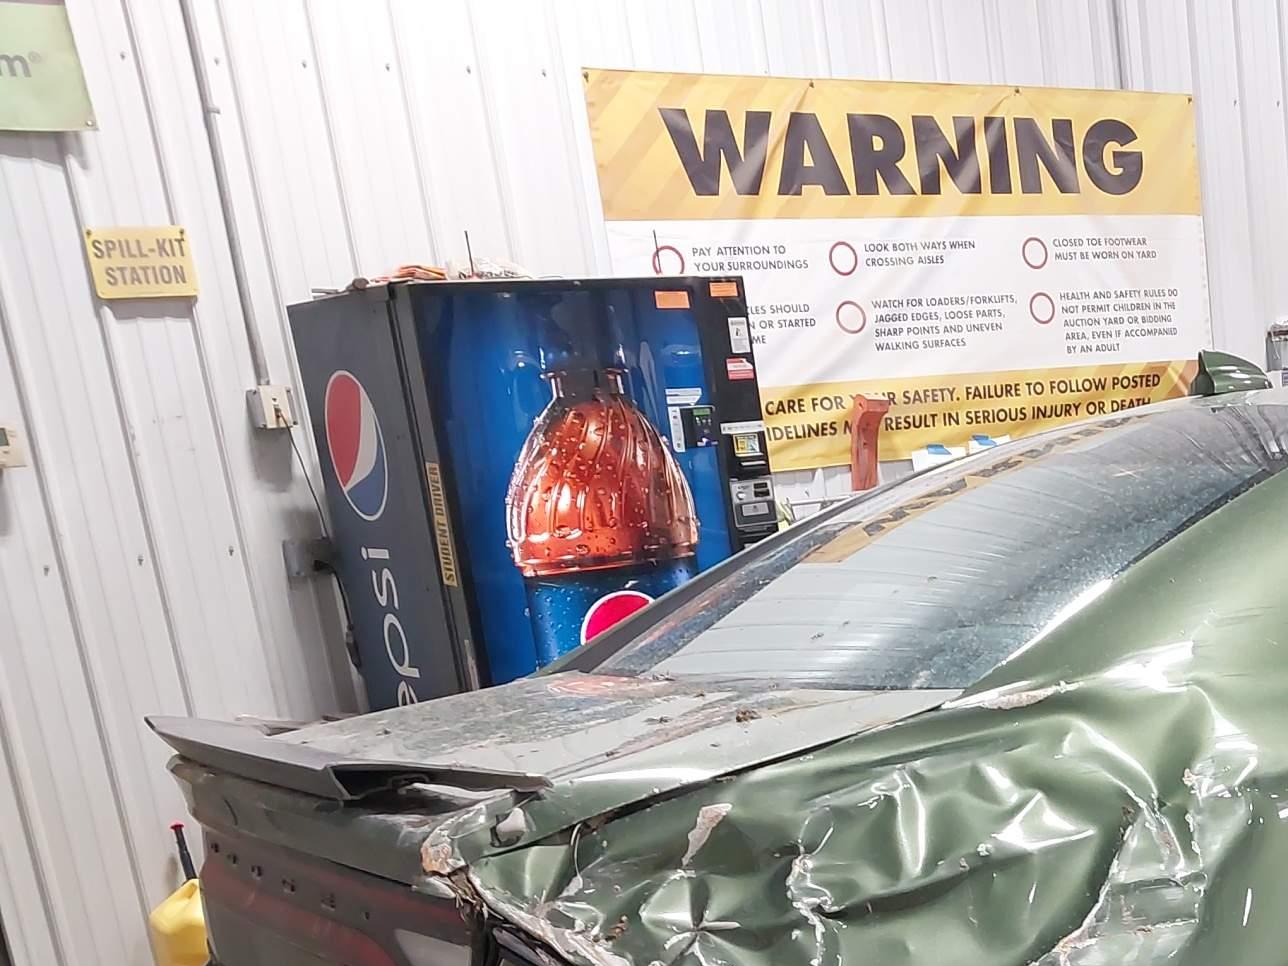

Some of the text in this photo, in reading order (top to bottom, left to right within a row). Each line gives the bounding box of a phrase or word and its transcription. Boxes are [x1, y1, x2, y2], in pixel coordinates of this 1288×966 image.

[658, 107, 1144, 196] WARNING
[92, 238, 185, 259] SPILL-KIT
[864, 240, 976, 253] LOOK BOTH WAYS WHEN
[1052, 238, 1147, 247] CLOSED TOE FOOTWEAR
[692, 245, 786, 257] PAY ATTENTION TO
[1054, 250, 1157, 261] MUST BE WORN ON YARD
[694, 259, 809, 272] YOUR SURROUNDINGS
[865, 255, 944, 267] CROSSING AISLES
[105, 265, 187, 286] STATION
[1060, 288, 1178, 301] HEALTH AND SAFETY RULES DO
[872, 294, 1018, 309] WATCH FOR LOADERS/FORKLIFTS,
[1061, 302, 1176, 314] NOT PERMIT CHILDREN IN THE
[770, 303, 809, 314] SHOULD
[874, 309, 1006, 324] JAGGED EDGES, LOOSE PARTS,
[1063, 315, 1172, 328] AUCTION YARD OR BIDDING
[759, 320, 774, 329] OR
[778, 318, 816, 329] STARTED
[874, 322, 1003, 338] SHARP POINTS AND UNEVEN
[751, 335, 766, 345] ME
[1065, 327, 1177, 341] AREA, EVEN IF ACCOMPANIED
[874, 339, 967, 352] WALKING SURFACES
[1066, 343, 1120, 354] BY AN ADULT
[765, 398, 806, 416] CARE
[812, 395, 846, 412] FOR
[902, 387, 960, 405] SAFETY.
[966, 383, 1021, 400] FAILURE
[1025, 382, 1045, 396] TO
[1050, 377, 1108, 394] FOLLOW
[1112, 374, 1160, 390] POSTED
[766, 421, 837, 441] IDELINES
[885, 414, 937, 431] RESULT
[943, 413, 960, 426] IN
[966, 407, 1027, 425] SERIOUS
[1032, 402, 1082, 420] INJURY
[1086, 401, 1106, 416] OR
[428, 466, 455, 582] STUDENT DRIVER
[361, 546, 420, 707] epsi
